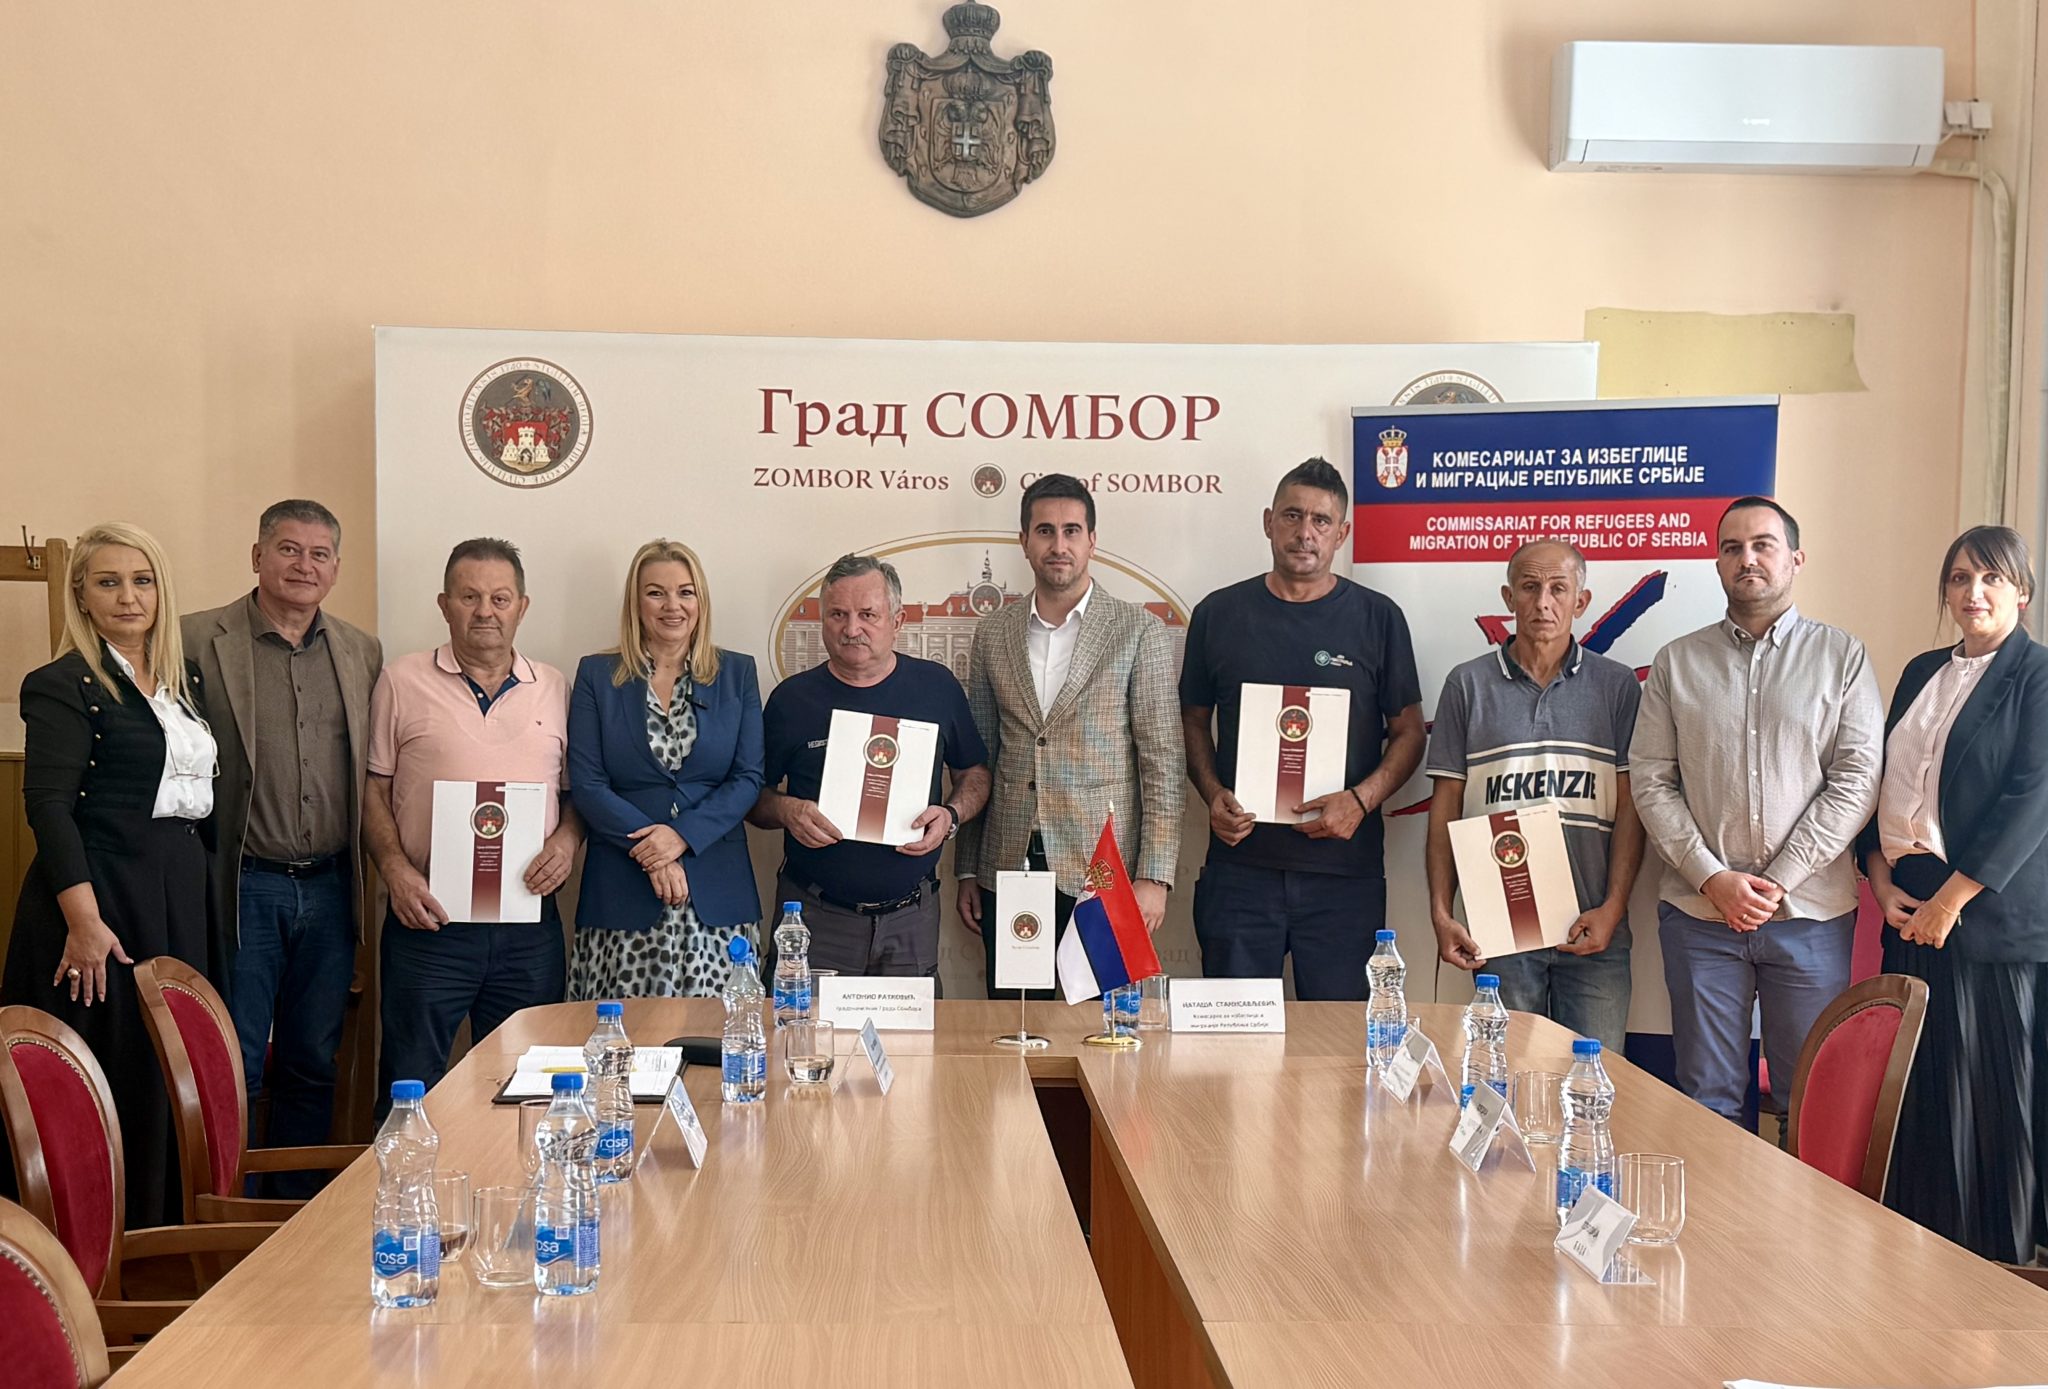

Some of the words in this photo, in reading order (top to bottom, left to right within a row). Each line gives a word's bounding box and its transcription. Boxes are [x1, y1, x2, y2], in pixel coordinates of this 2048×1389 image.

[757, 387, 908, 448] Град
[926, 391, 1222, 442] СОМБОР
[1433, 450, 1556, 469] КОМЕСАРИЈАТ
[1560, 449, 1583, 465] ЗА
[1588, 446, 1688, 467] ИЗБЕГЛИЦЕ
[753, 468, 873, 490] ZOMBOR
[880, 468, 950, 490] Város
[1106, 472, 1224, 495] SOMBOR
[1416, 472, 1426, 488] И
[1432, 470, 1528, 490] МИГРАЦИЈЕ
[1533, 468, 1632, 487] РЕПУБЛИКЕ
[1638, 466, 1705, 484] СРБИЈЕ
[1426, 515, 1537, 532] COMMISSARIAT
[1541, 514, 1571, 530] FOR
[1575, 513, 1655, 529] REFUGEES
[1658, 512, 1690, 528] AND
[1409, 535, 1490, 550] MIGRATION
[1493, 534, 1513, 549] OF
[1627, 533, 1647, 548] OF
[1651, 531, 1708, 547] SERBIA
[536, 1240, 559, 1253] osa
